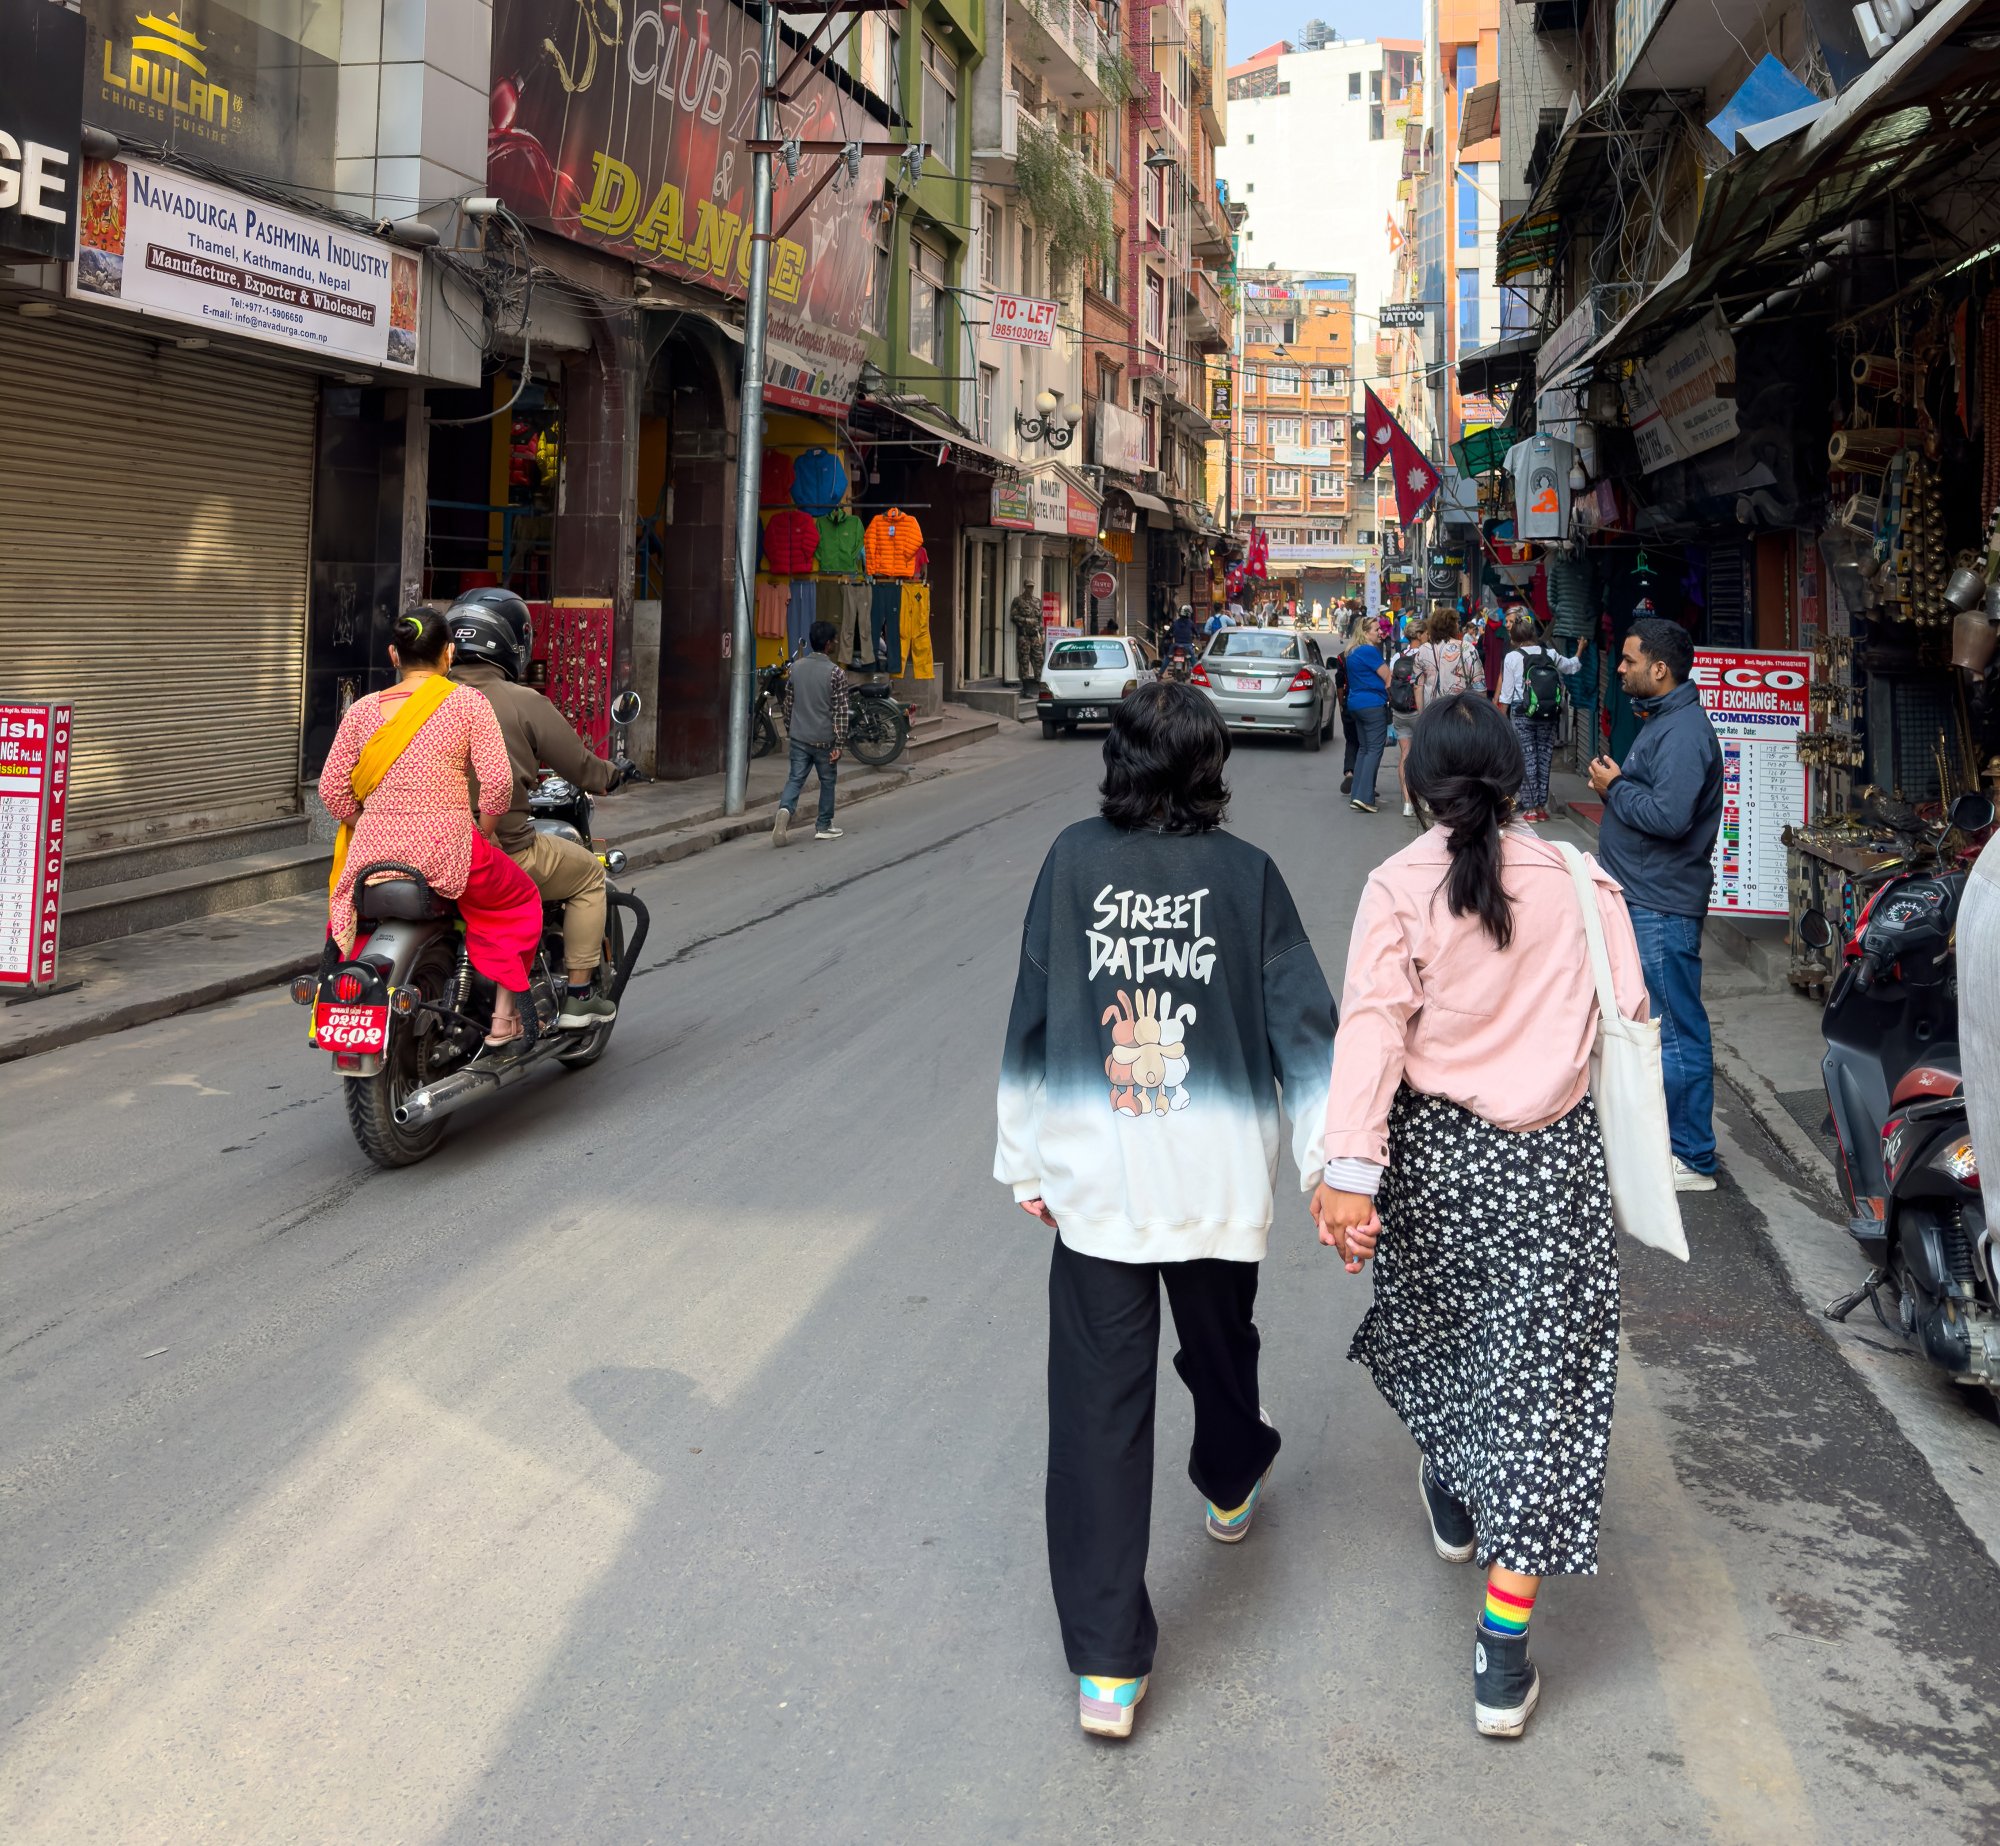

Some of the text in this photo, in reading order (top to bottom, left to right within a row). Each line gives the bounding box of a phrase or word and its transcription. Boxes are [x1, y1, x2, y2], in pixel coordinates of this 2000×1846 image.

[103, 40, 229, 128] LOULAN
[627, 10, 733, 126] CLUB
[102, 87, 227, 145] CHINESE CUISINE
[713, 150, 734, 201] &
[133, 172, 389, 279] NAVADURGA PASHMINA INDUSTRY
[187, 232, 351, 291] Thamel, Kathmandu, Nepal
[151, 249, 373, 321] Manufacture, Exporter & Wholesaler
[203, 305, 328, 342] E-mail: info@navadurga.com.np
[1000, 299, 1016, 319] TO
[1028, 303, 1054, 325] LET
[1380, 311, 1424, 323] TATTOO
[795, 323, 826, 355] Compass
[1216, 387, 1228, 410] SPA
[1688, 667, 1805, 690] ECO
[1710, 712, 1800, 726] COMMISSION
[1722, 689, 1778, 711] EXCHANGE
[1780, 700, 1791, 711] Pvt.
[1793, 701, 1805, 712] Ltd.
[1, 718, 45, 739] ish
[1727, 727, 1738, 735] Rate
[0, 741, 20, 761] NGE
[53, 710, 70, 804] MONEY
[1093, 884, 1209, 937] STREET
[1085, 930, 1216, 984] DATING
